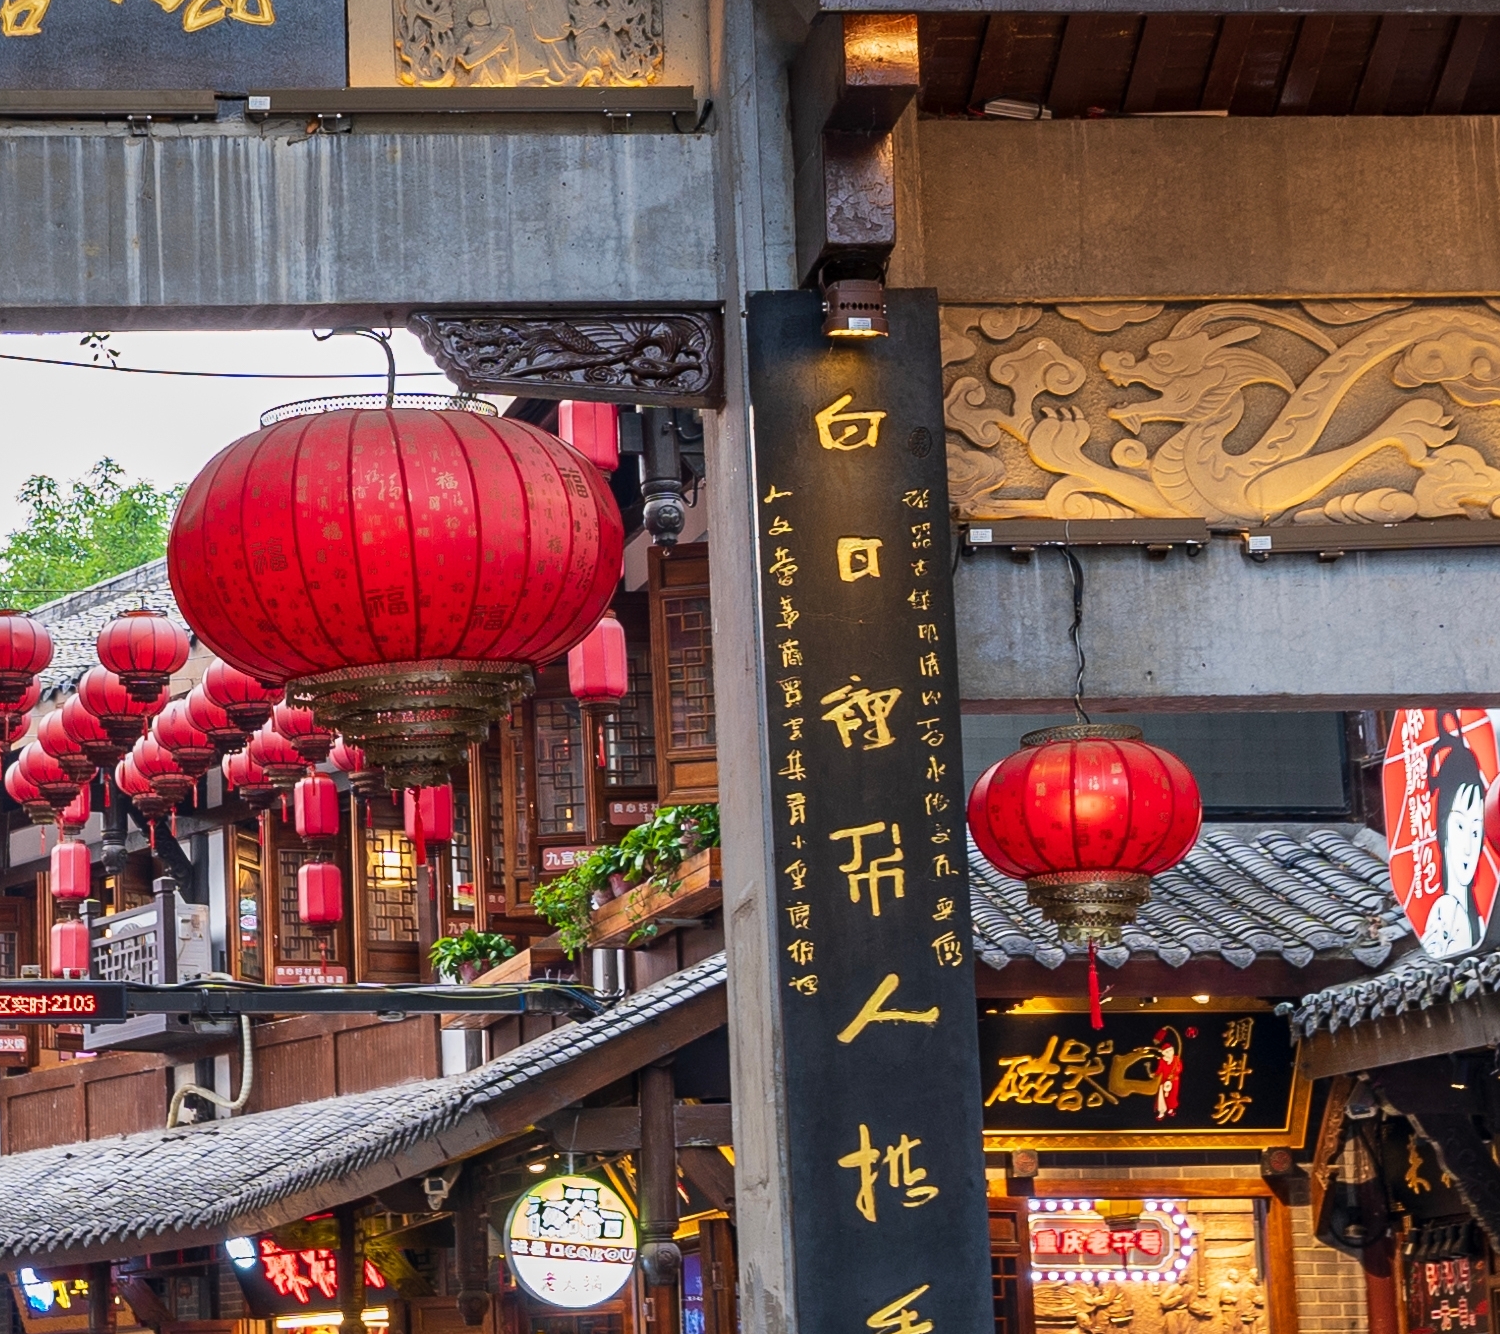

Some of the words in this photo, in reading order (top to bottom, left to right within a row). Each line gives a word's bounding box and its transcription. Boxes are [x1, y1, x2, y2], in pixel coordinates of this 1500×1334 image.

[984, 1035, 1164, 1112] 磁器口
[1210, 1017, 1255, 1125] 调料坊
